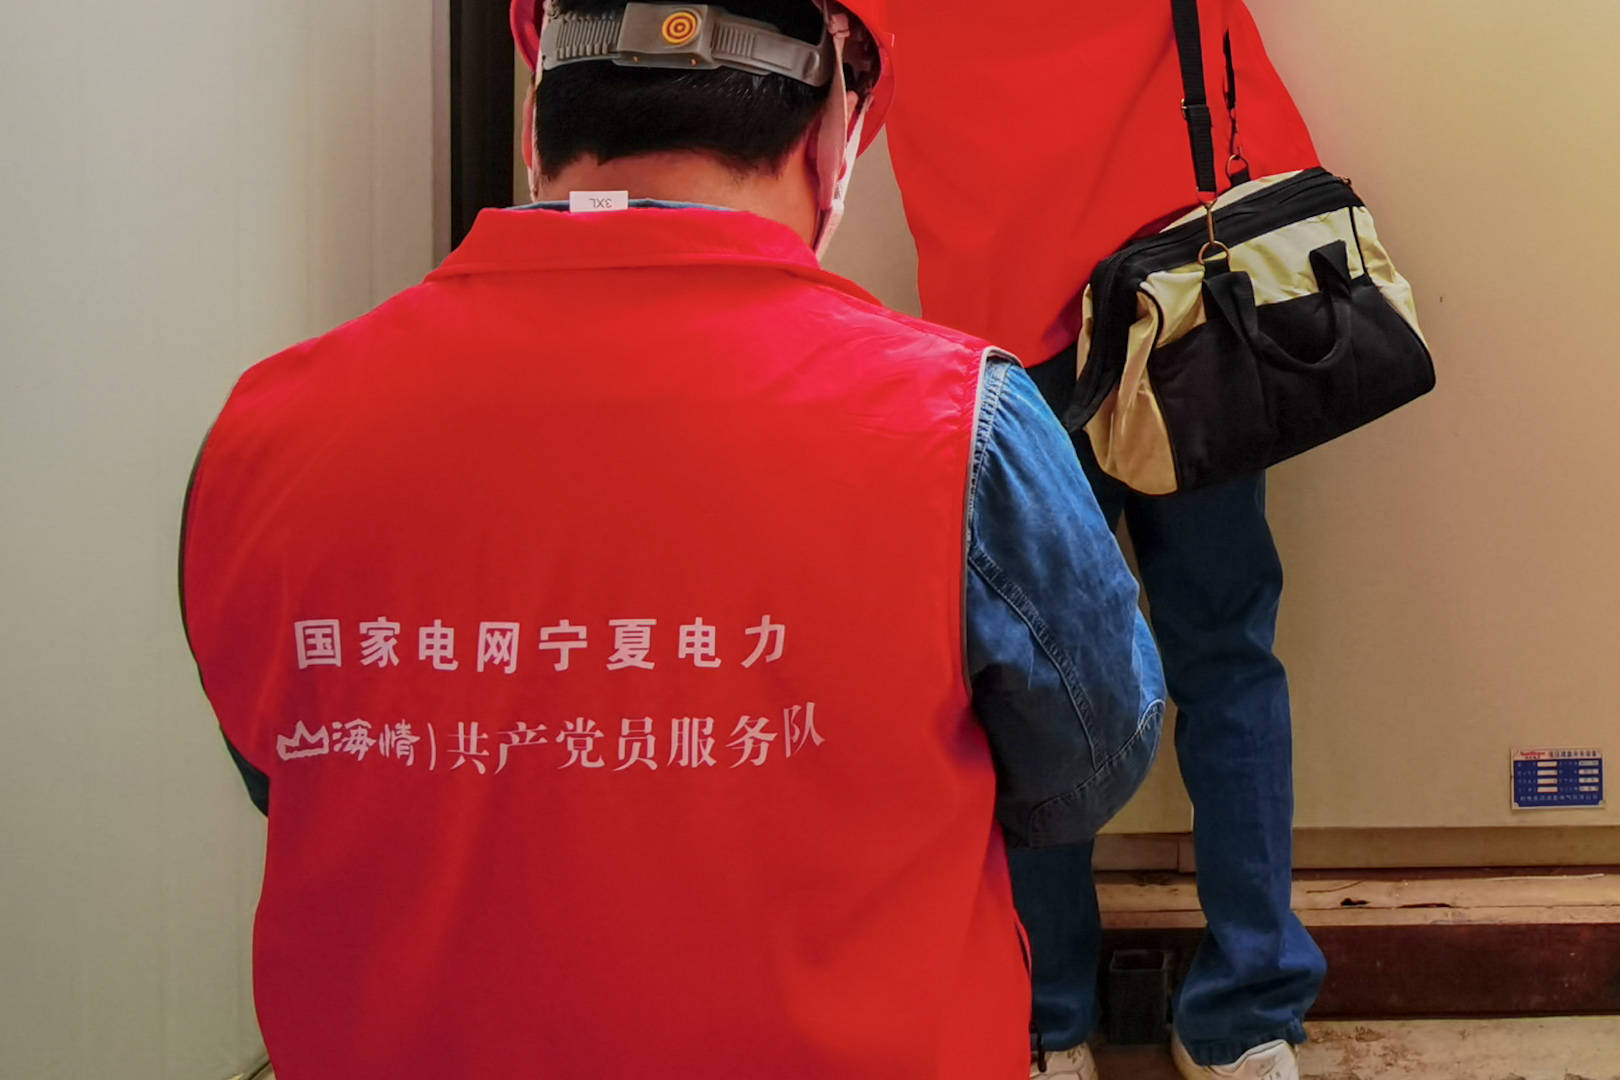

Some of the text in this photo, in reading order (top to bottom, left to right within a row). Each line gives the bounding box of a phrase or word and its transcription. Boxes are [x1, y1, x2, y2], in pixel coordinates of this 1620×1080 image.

[589, 198, 613, 209] 3XL
[293, 614, 788, 675] 国家电网宁夏电力
